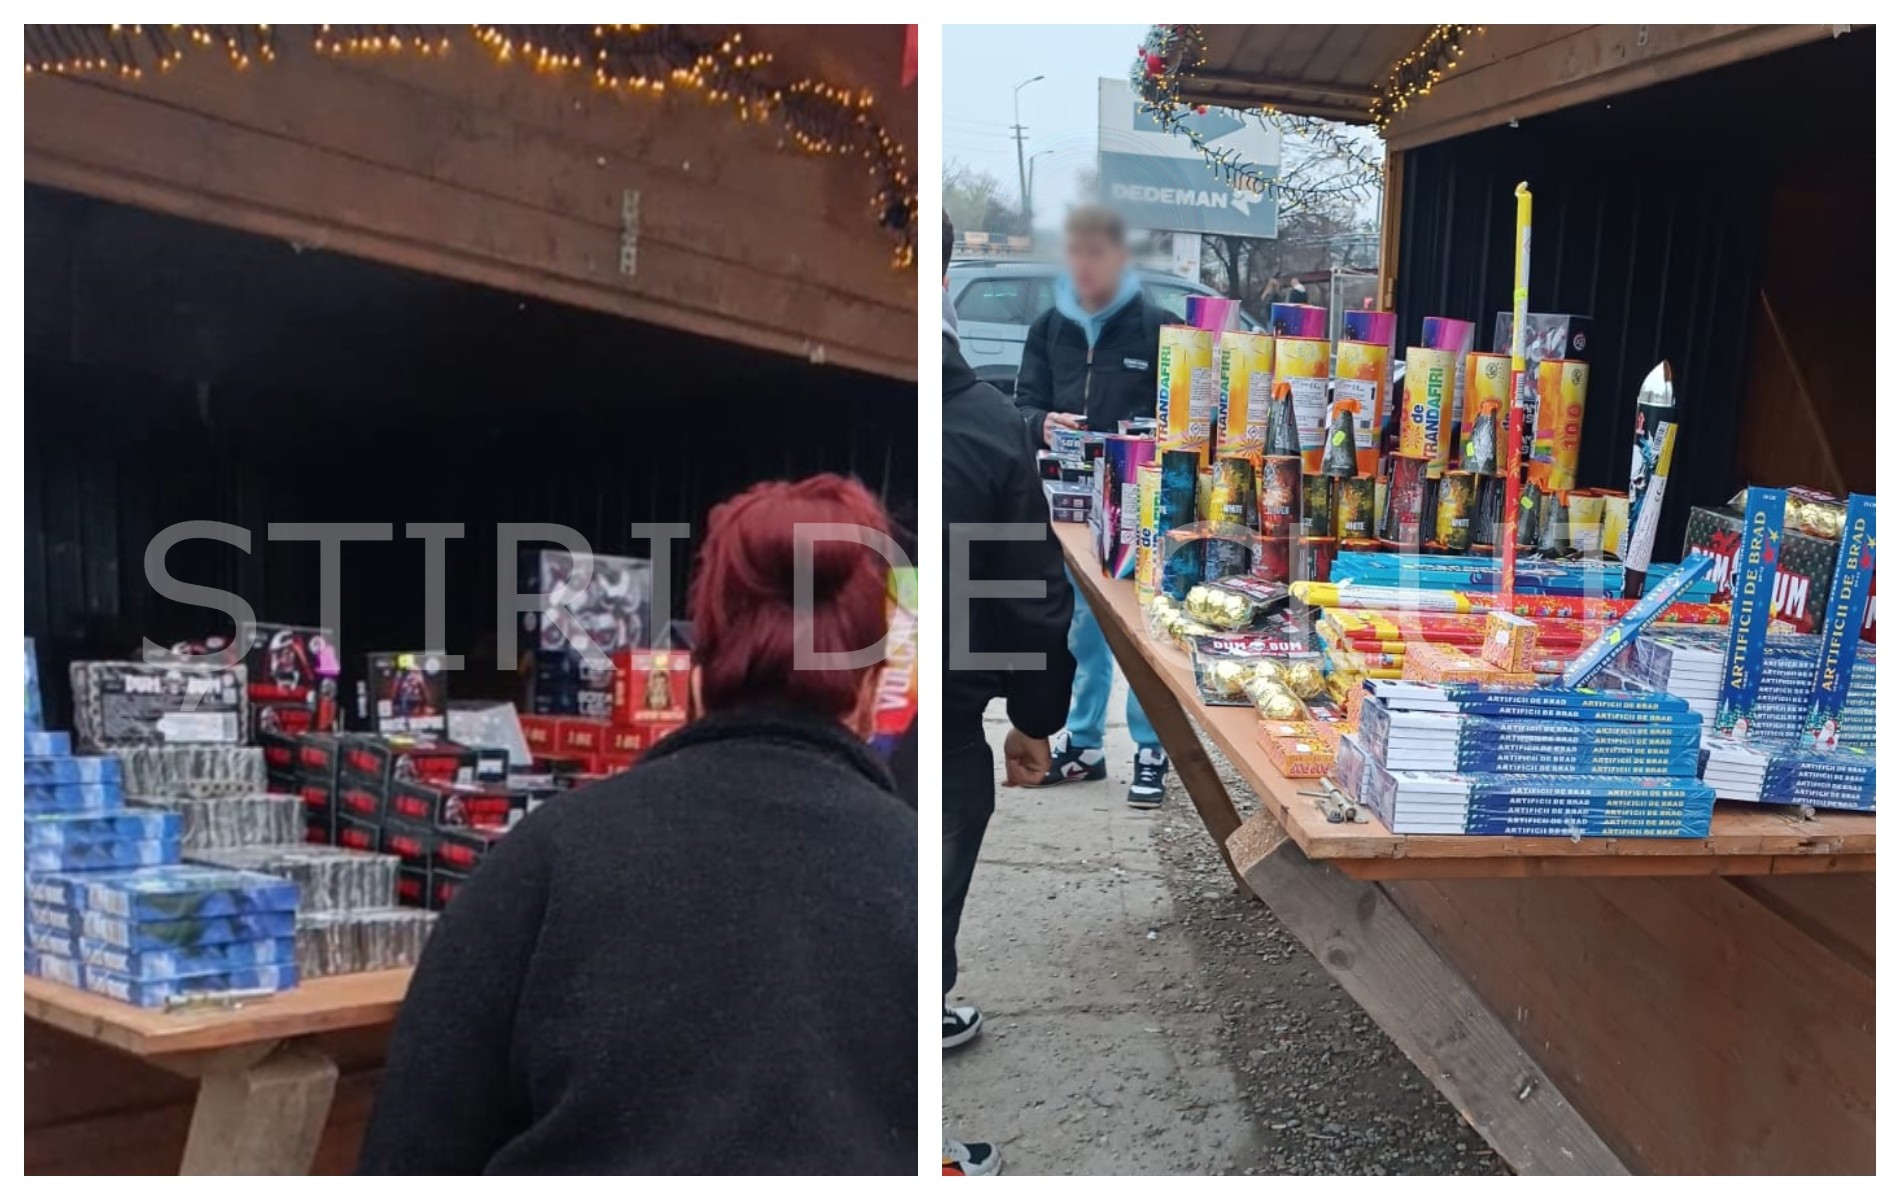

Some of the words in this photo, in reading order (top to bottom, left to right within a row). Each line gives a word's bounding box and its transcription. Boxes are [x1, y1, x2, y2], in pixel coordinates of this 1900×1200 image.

[1111, 183, 1228, 208] DEDEMAN
[1158, 345, 1171, 443] TRANDAFIRI
[1218, 350, 1231, 446] TRANDAFIRI
[1411, 405, 1424, 424] de
[1423, 368, 1443, 460] TRANDAFIRI
[1563, 403, 1582, 450] 100
[1223, 505, 1243, 514] WHITE
[1142, 528, 1151, 547] de
[1748, 511, 1767, 564] BRAD
[1847, 518, 1866, 570] BRAD
[1744, 569, 1758, 596] DE
[1772, 571, 1810, 619] UM
[1840, 574, 1855, 601] DE
[1730, 600, 1754, 690] ARTIFICII
[1822, 604, 1849, 691] ARTIFICII
[1488, 695, 1528, 704] ARTIFICII
[1530, 697, 1541, 705] DE
[1500, 707, 1540, 716] ARTIFICII
[1542, 708, 1553, 716] DE
[1555, 709, 1579, 717] BRAD
[1583, 700, 1621, 708] ARTIFICII
[1623, 701, 1634, 709] DE
[1635, 702, 1658, 710] BRAD
[1596, 712, 1634, 721] ARTIFICII
[1636, 713, 1647, 721] DE
[1649, 714, 1672, 722] BRAD
